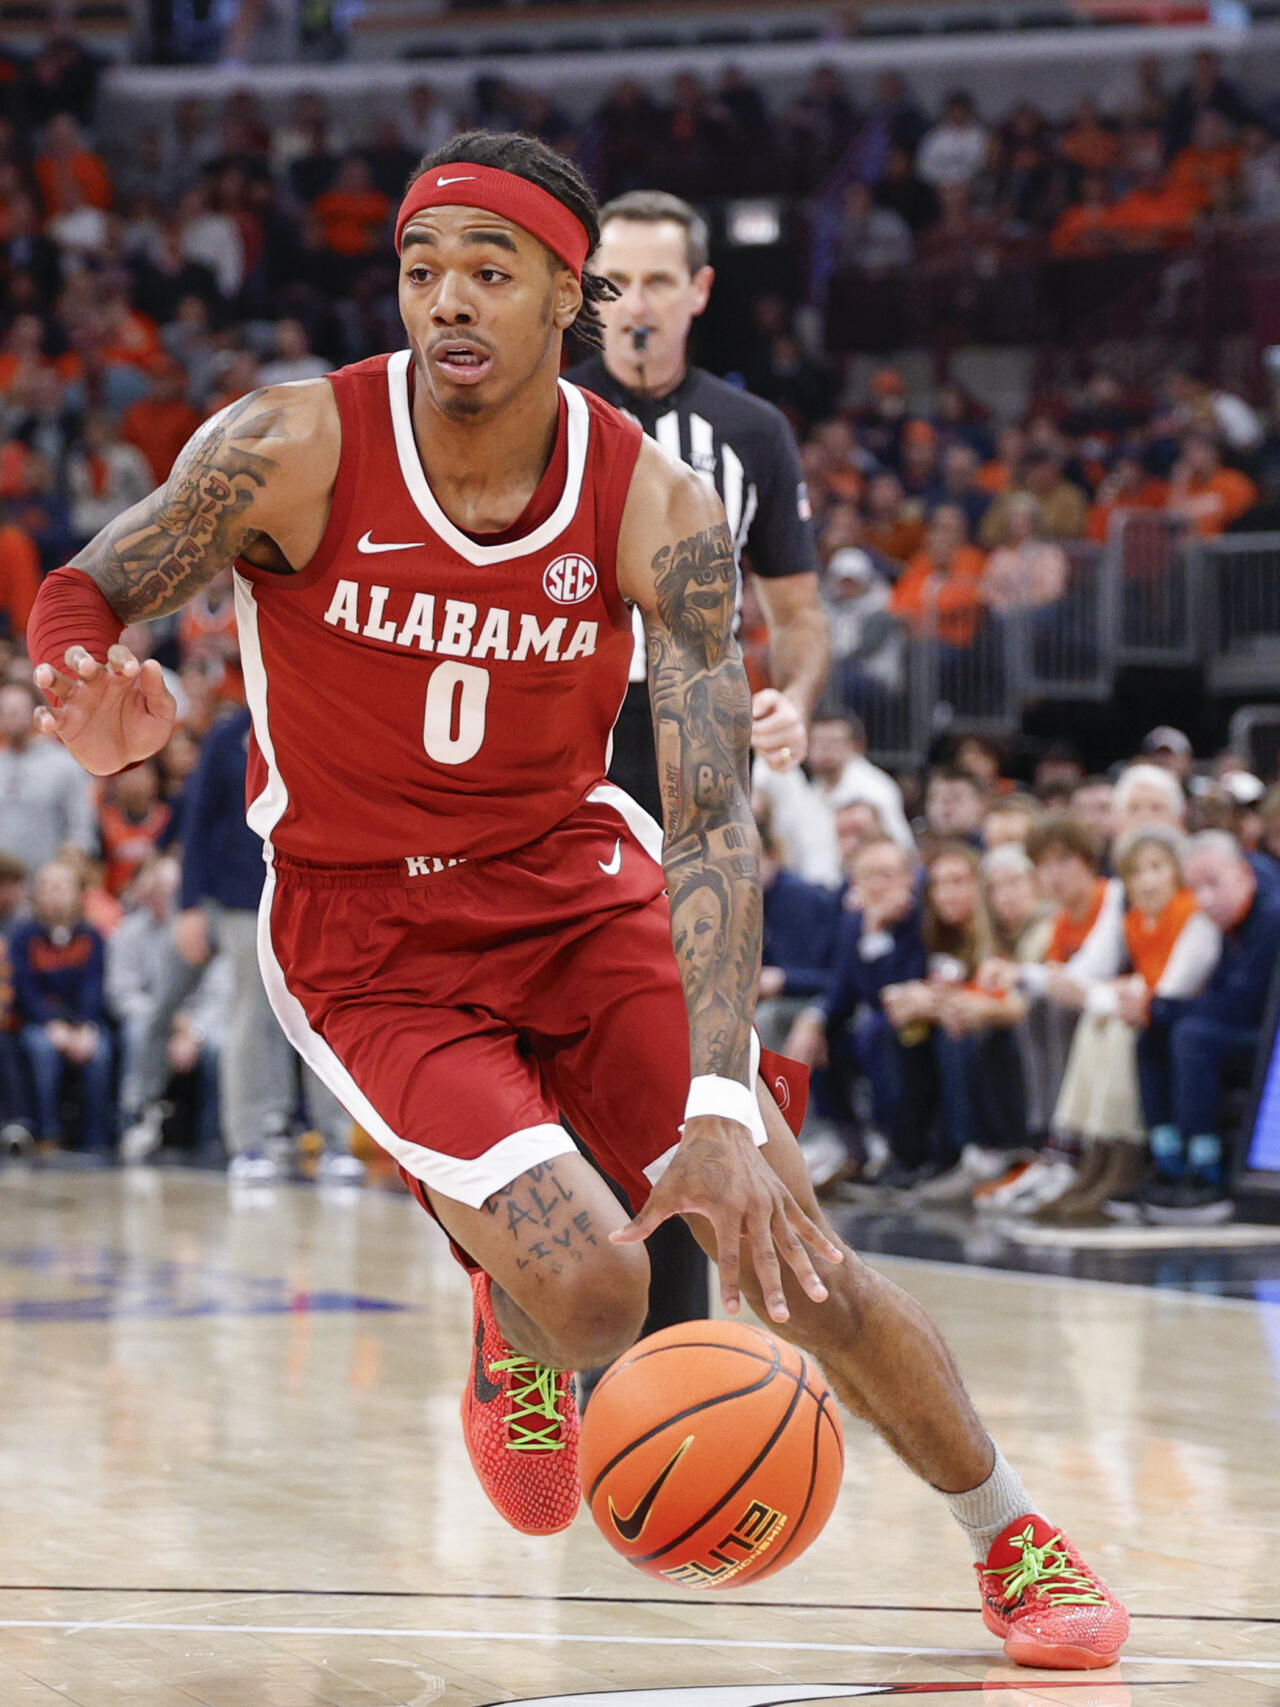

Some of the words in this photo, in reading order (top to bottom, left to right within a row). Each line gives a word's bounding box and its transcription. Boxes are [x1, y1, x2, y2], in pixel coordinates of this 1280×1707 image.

[323, 579, 599, 662] ALABAMA
[548, 557, 593, 602] SEC
[423, 660, 490, 765] 0
[660, 1499, 782, 1585] ELITE
